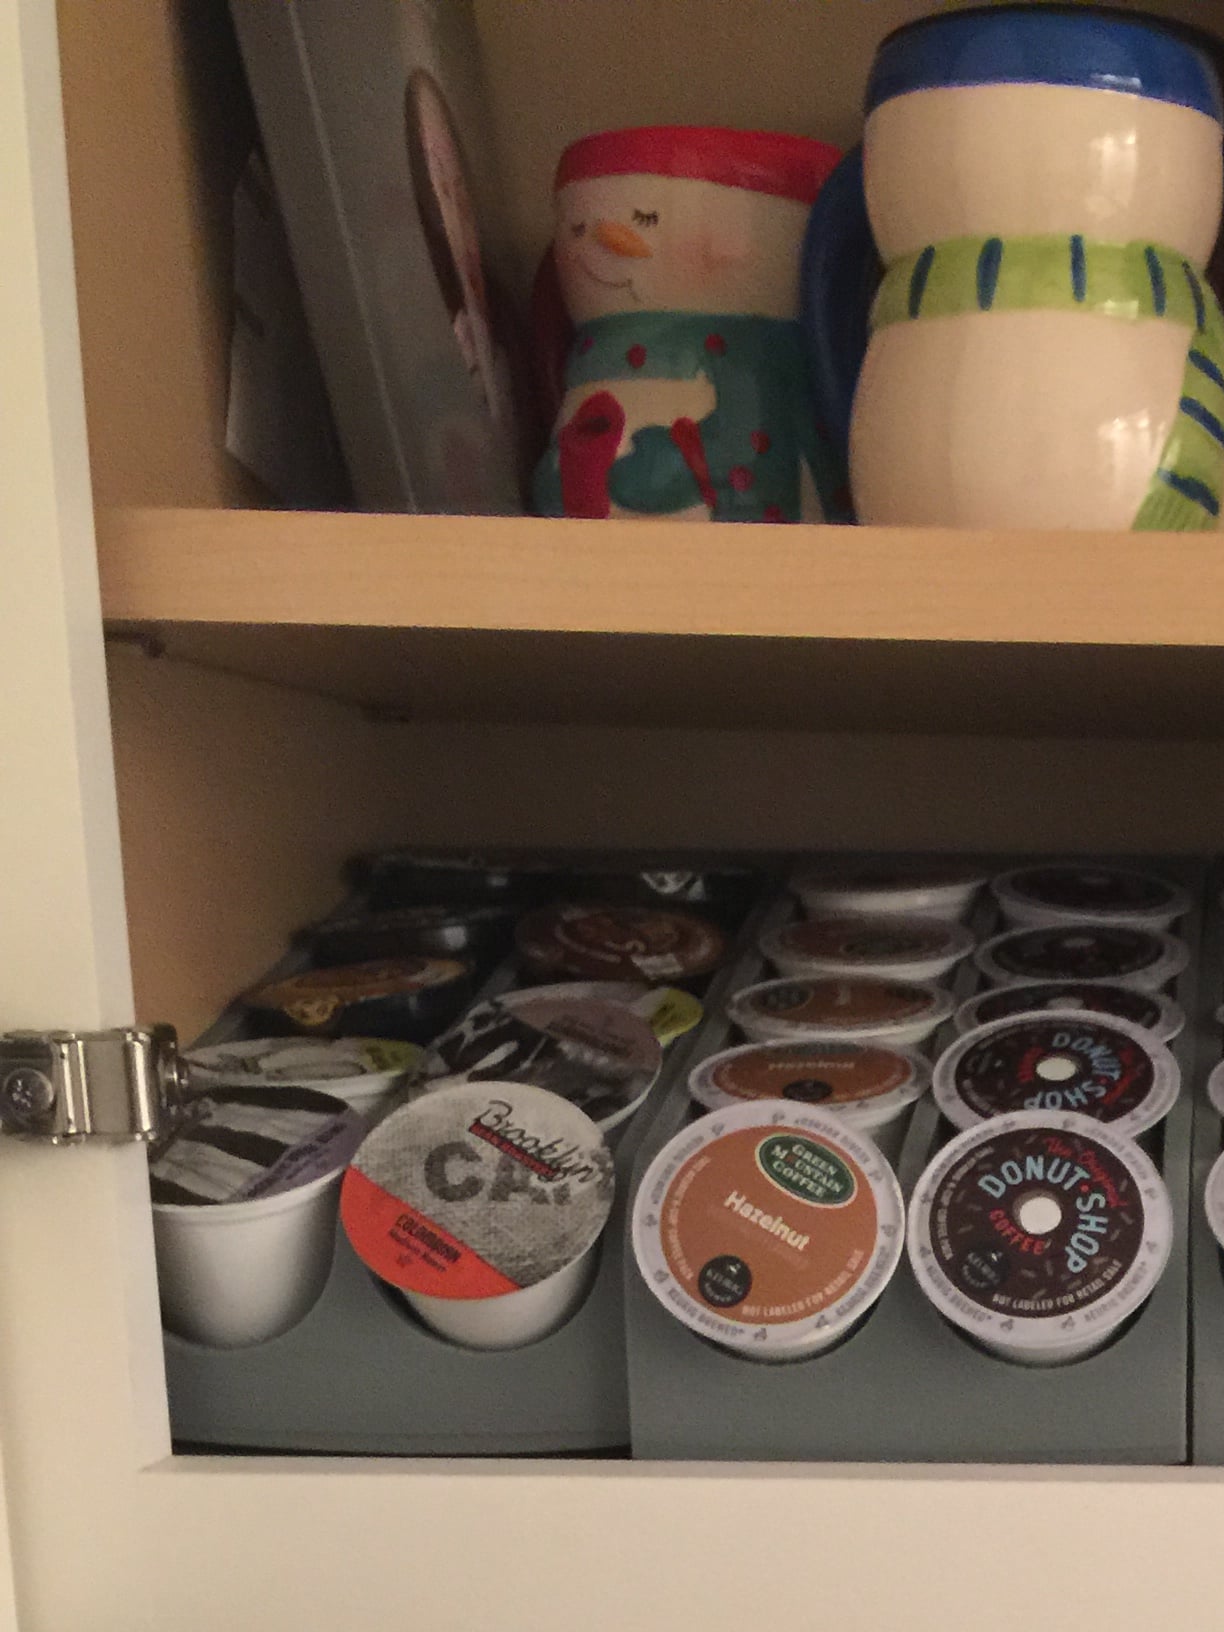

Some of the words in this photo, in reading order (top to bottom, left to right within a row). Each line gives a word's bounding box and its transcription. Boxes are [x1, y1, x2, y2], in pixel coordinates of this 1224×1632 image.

[472, 1099, 595, 1184] Brooklyn
[791, 1143, 838, 1176] GREEN
[771, 1160, 829, 1198] COFFEE
[723, 1189, 811, 1251] Hazelnut
[977, 1154, 1092, 1200] DONUT
[1065, 1192, 1110, 1274] SHOP
[988, 1208, 1047, 1256] COFFEE
